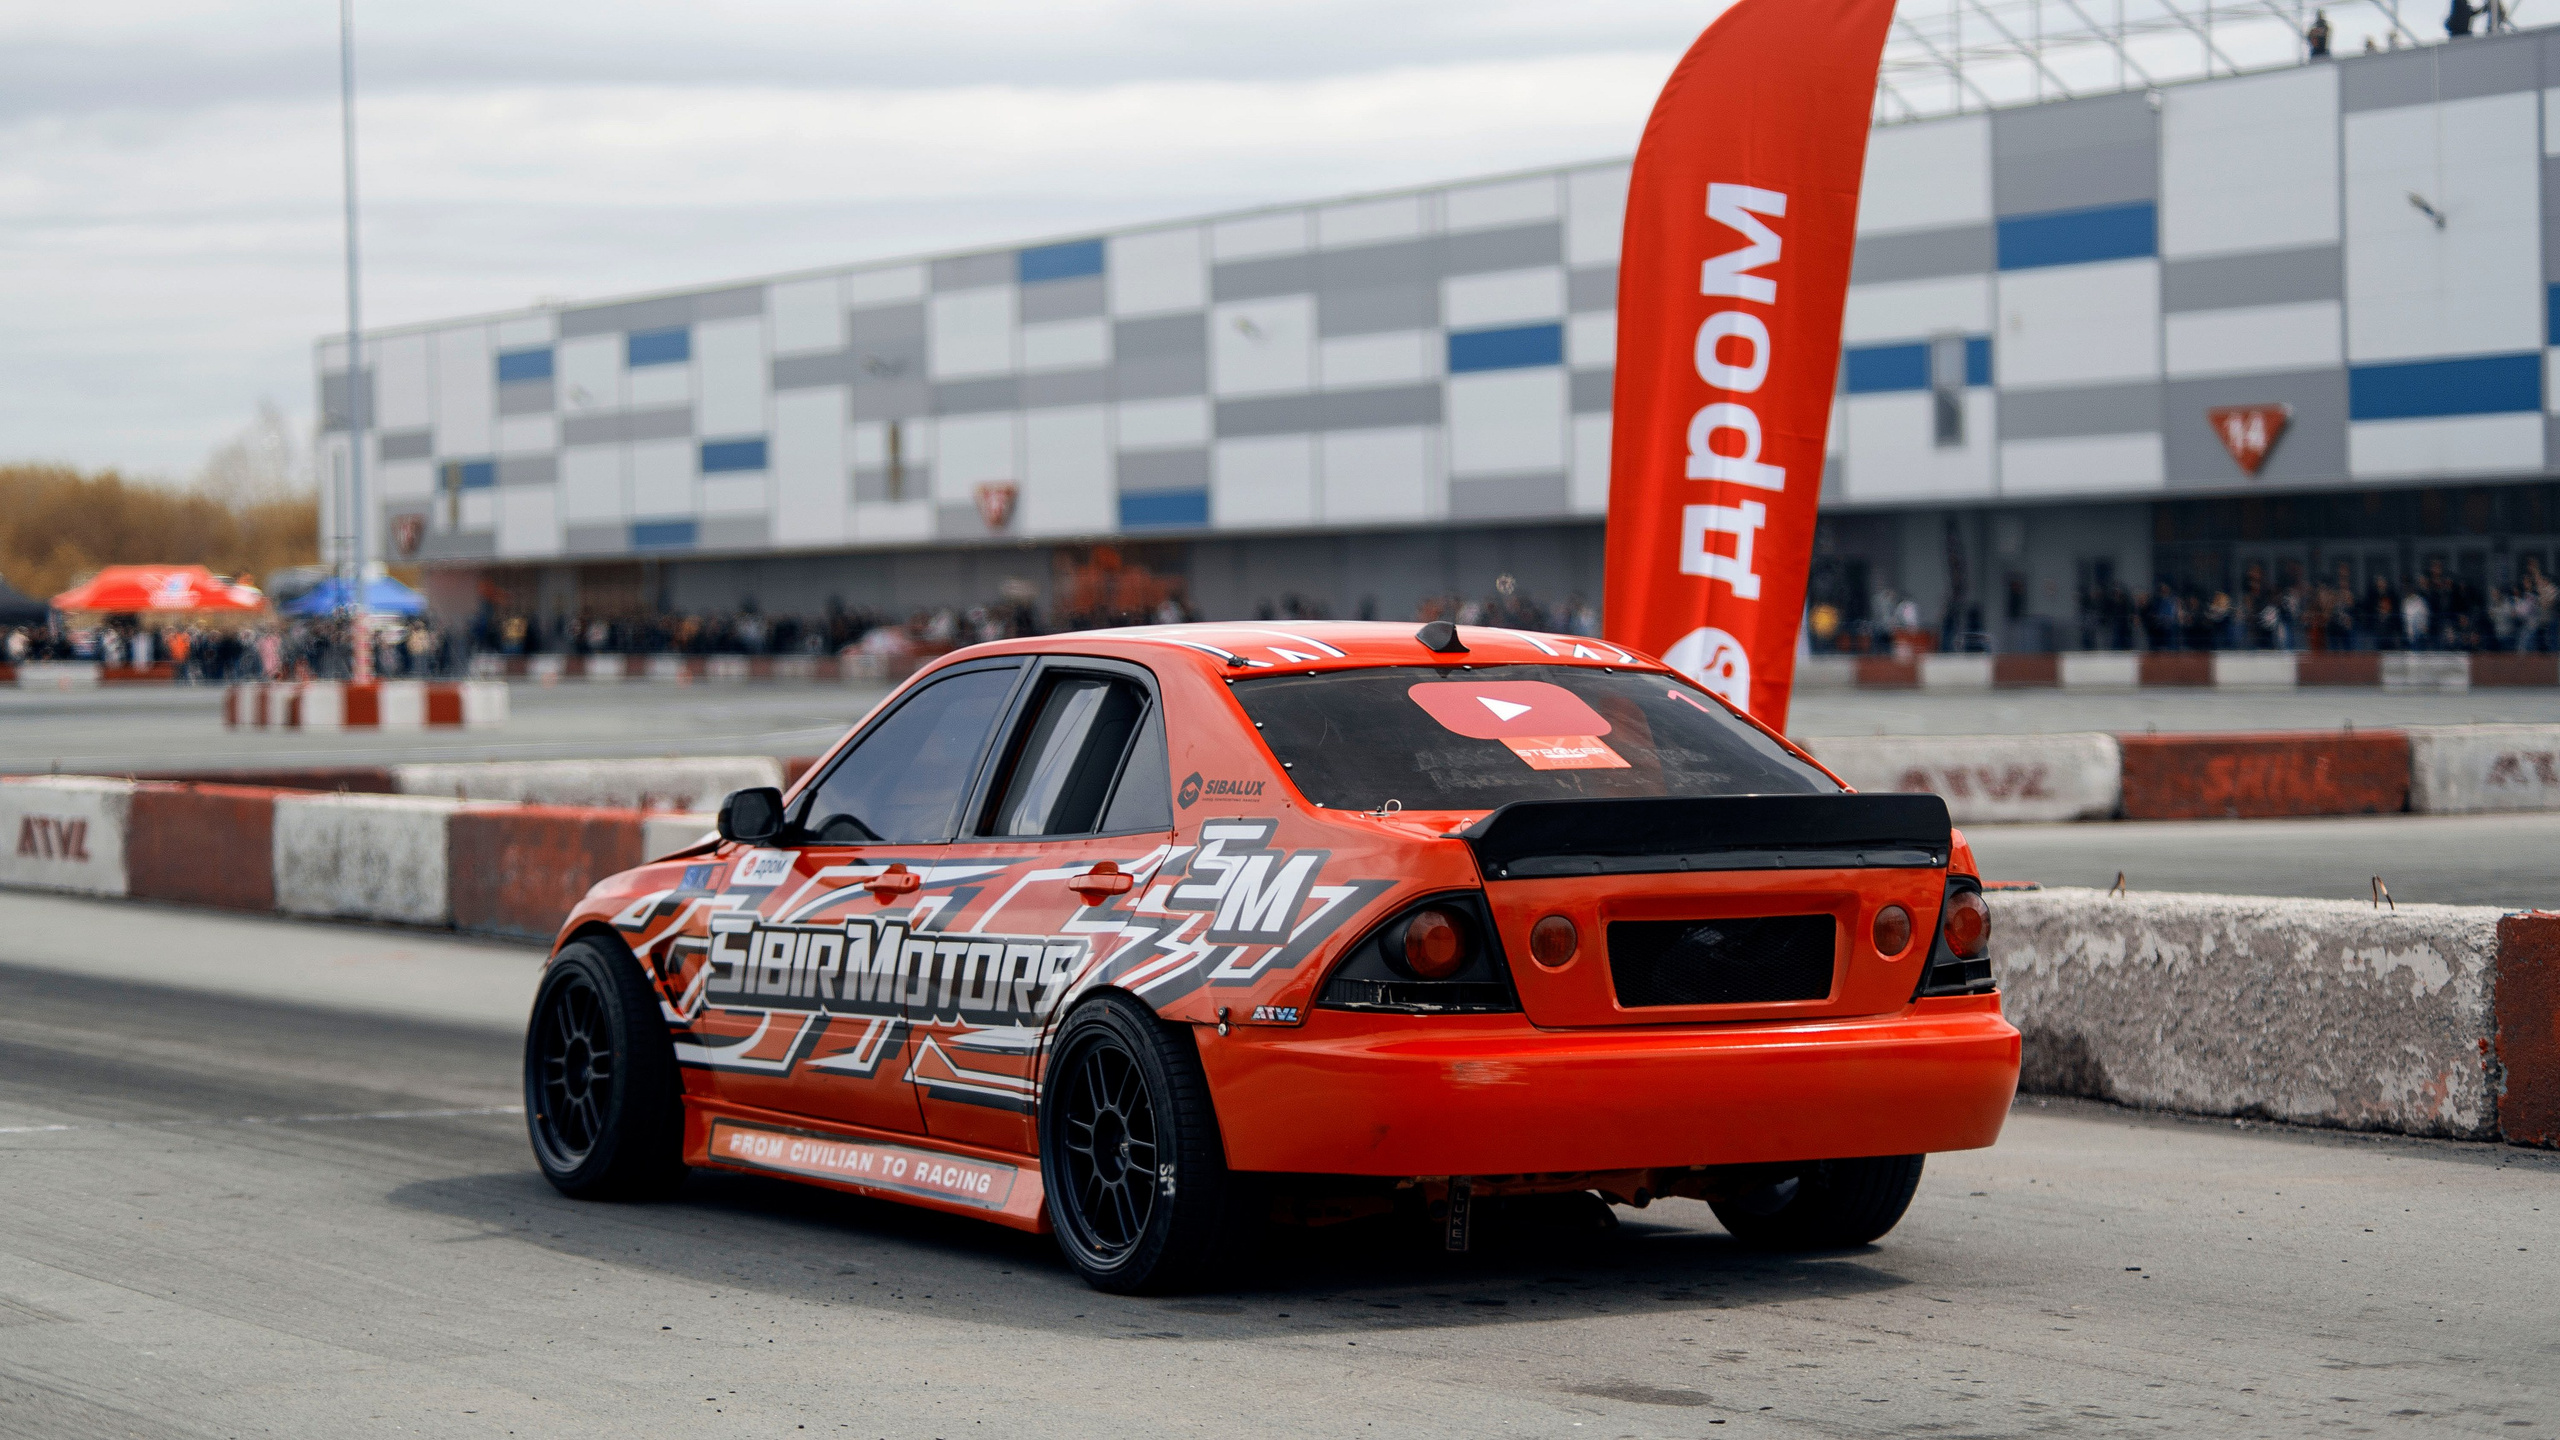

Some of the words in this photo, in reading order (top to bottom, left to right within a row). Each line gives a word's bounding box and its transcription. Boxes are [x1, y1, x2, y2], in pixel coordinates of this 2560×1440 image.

[2226, 413, 2265, 454] 14
[1205, 780, 1266, 796] SIBALUX
[16, 814, 89, 861] ATVL
[1174, 825, 1318, 932] SM
[1252, 1005, 1298, 1021] ATVL
[730, 1133, 783, 1158] FROM
[789, 1142, 874, 1171] CIVILIAN
[882, 1155, 907, 1177] TO
[914, 1162, 992, 1193] RACING
